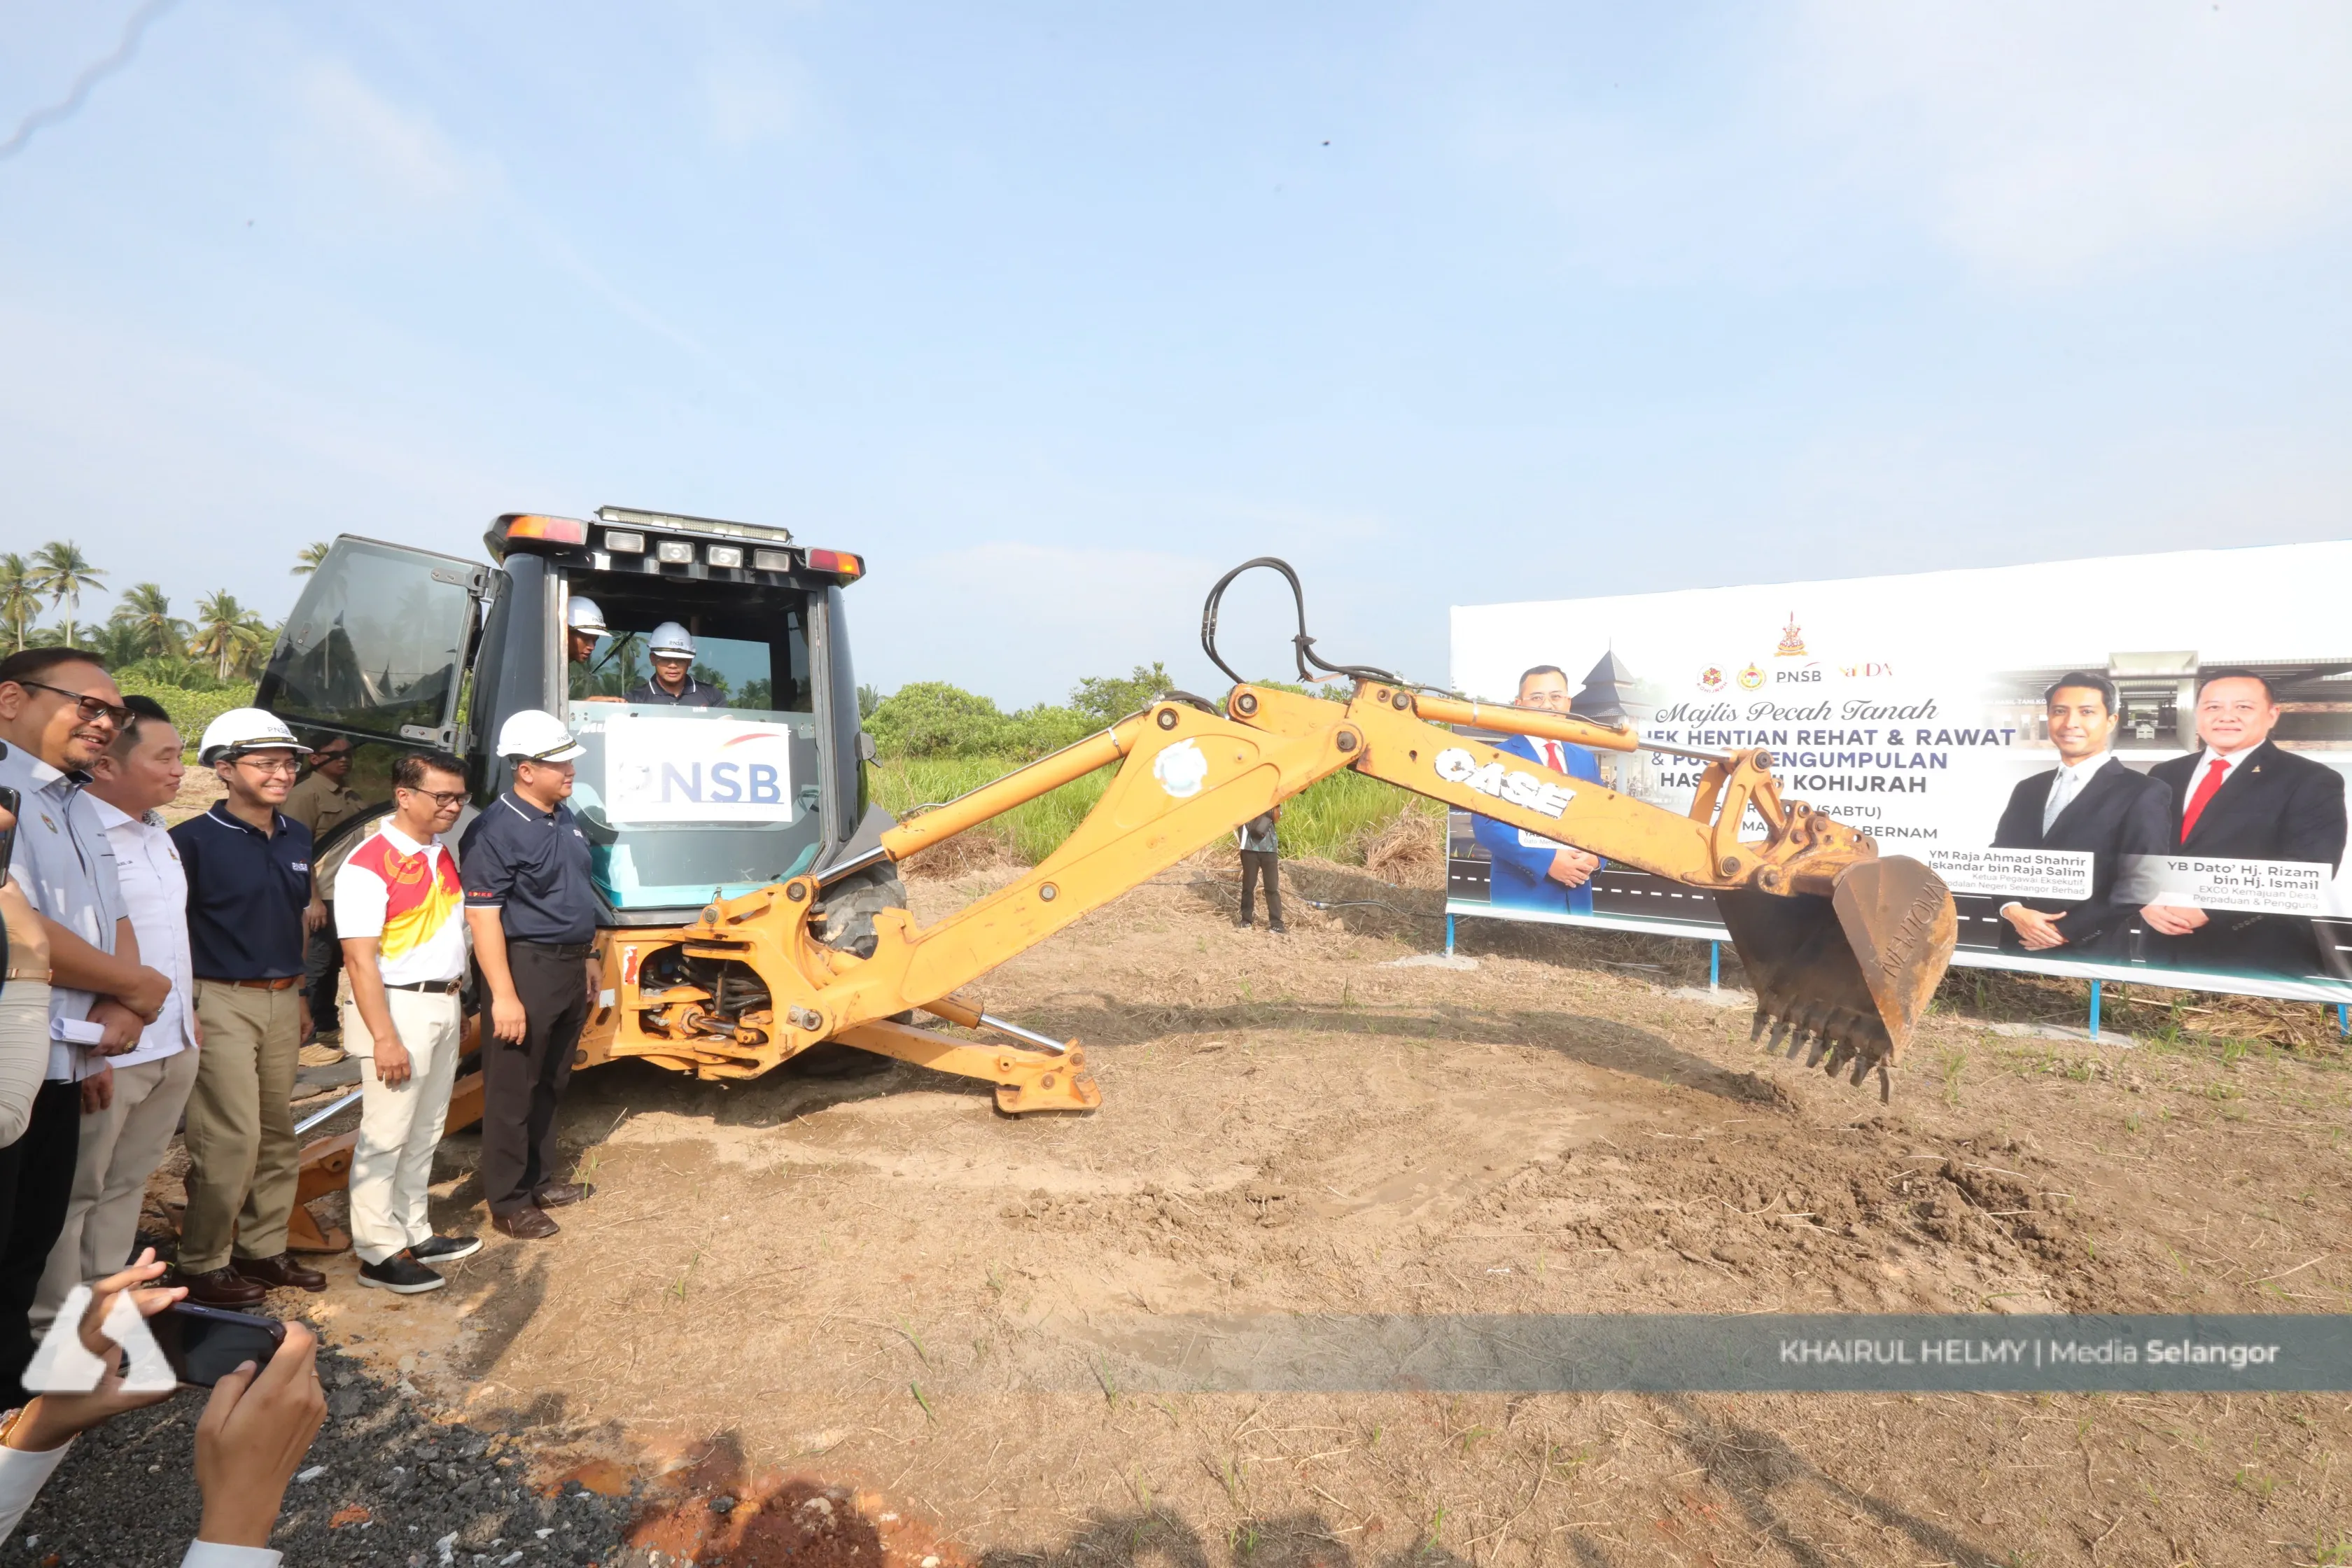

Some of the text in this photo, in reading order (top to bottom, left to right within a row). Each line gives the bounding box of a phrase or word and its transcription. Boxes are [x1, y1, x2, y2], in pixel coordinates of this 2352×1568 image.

[1777, 670, 1821, 682] PNSB
[1655, 699, 1939, 729] Majlis Pecah Tanah
[1688, 730, 1787, 746] HENTIAN
[1797, 729, 1878, 746] REHAT
[1887, 729, 1905, 746] &
[1916, 729, 2016, 746] RAWAT
[1651, 751, 1665, 766] &
[1772, 752, 1947, 769] ENGUMPULAN
[1434, 747, 1577, 820] CASE
[1793, 774, 1926, 793] KOHIJRAH
[1863, 826, 1938, 839] BERNAM
[1929, 850, 2086, 867] YM Raja Ahmad Shahrir
[1928, 860, 2085, 877] Iskandar bin Raja Salim
[2167, 862, 2189, 872] YB
[2241, 865, 2262, 877] Hj.
[2268, 867, 2319, 878] Rizam
[1972, 873, 1998, 881] Ketua
[2000, 874, 2038, 885] Pegawai
[2213, 875, 2319, 890] bin Hj. Ismail
[1978, 882, 2007, 891] Negeri
[2010, 884, 2049, 893] Selangor
[2052, 886, 2085, 895] Berhad
[2199, 886, 2229, 895] EXCO
[2232, 888, 2286, 898] Kemajuan
[2193, 895, 2250, 906] Perpaduan
[2264, 899, 2319, 910] Pengguna
